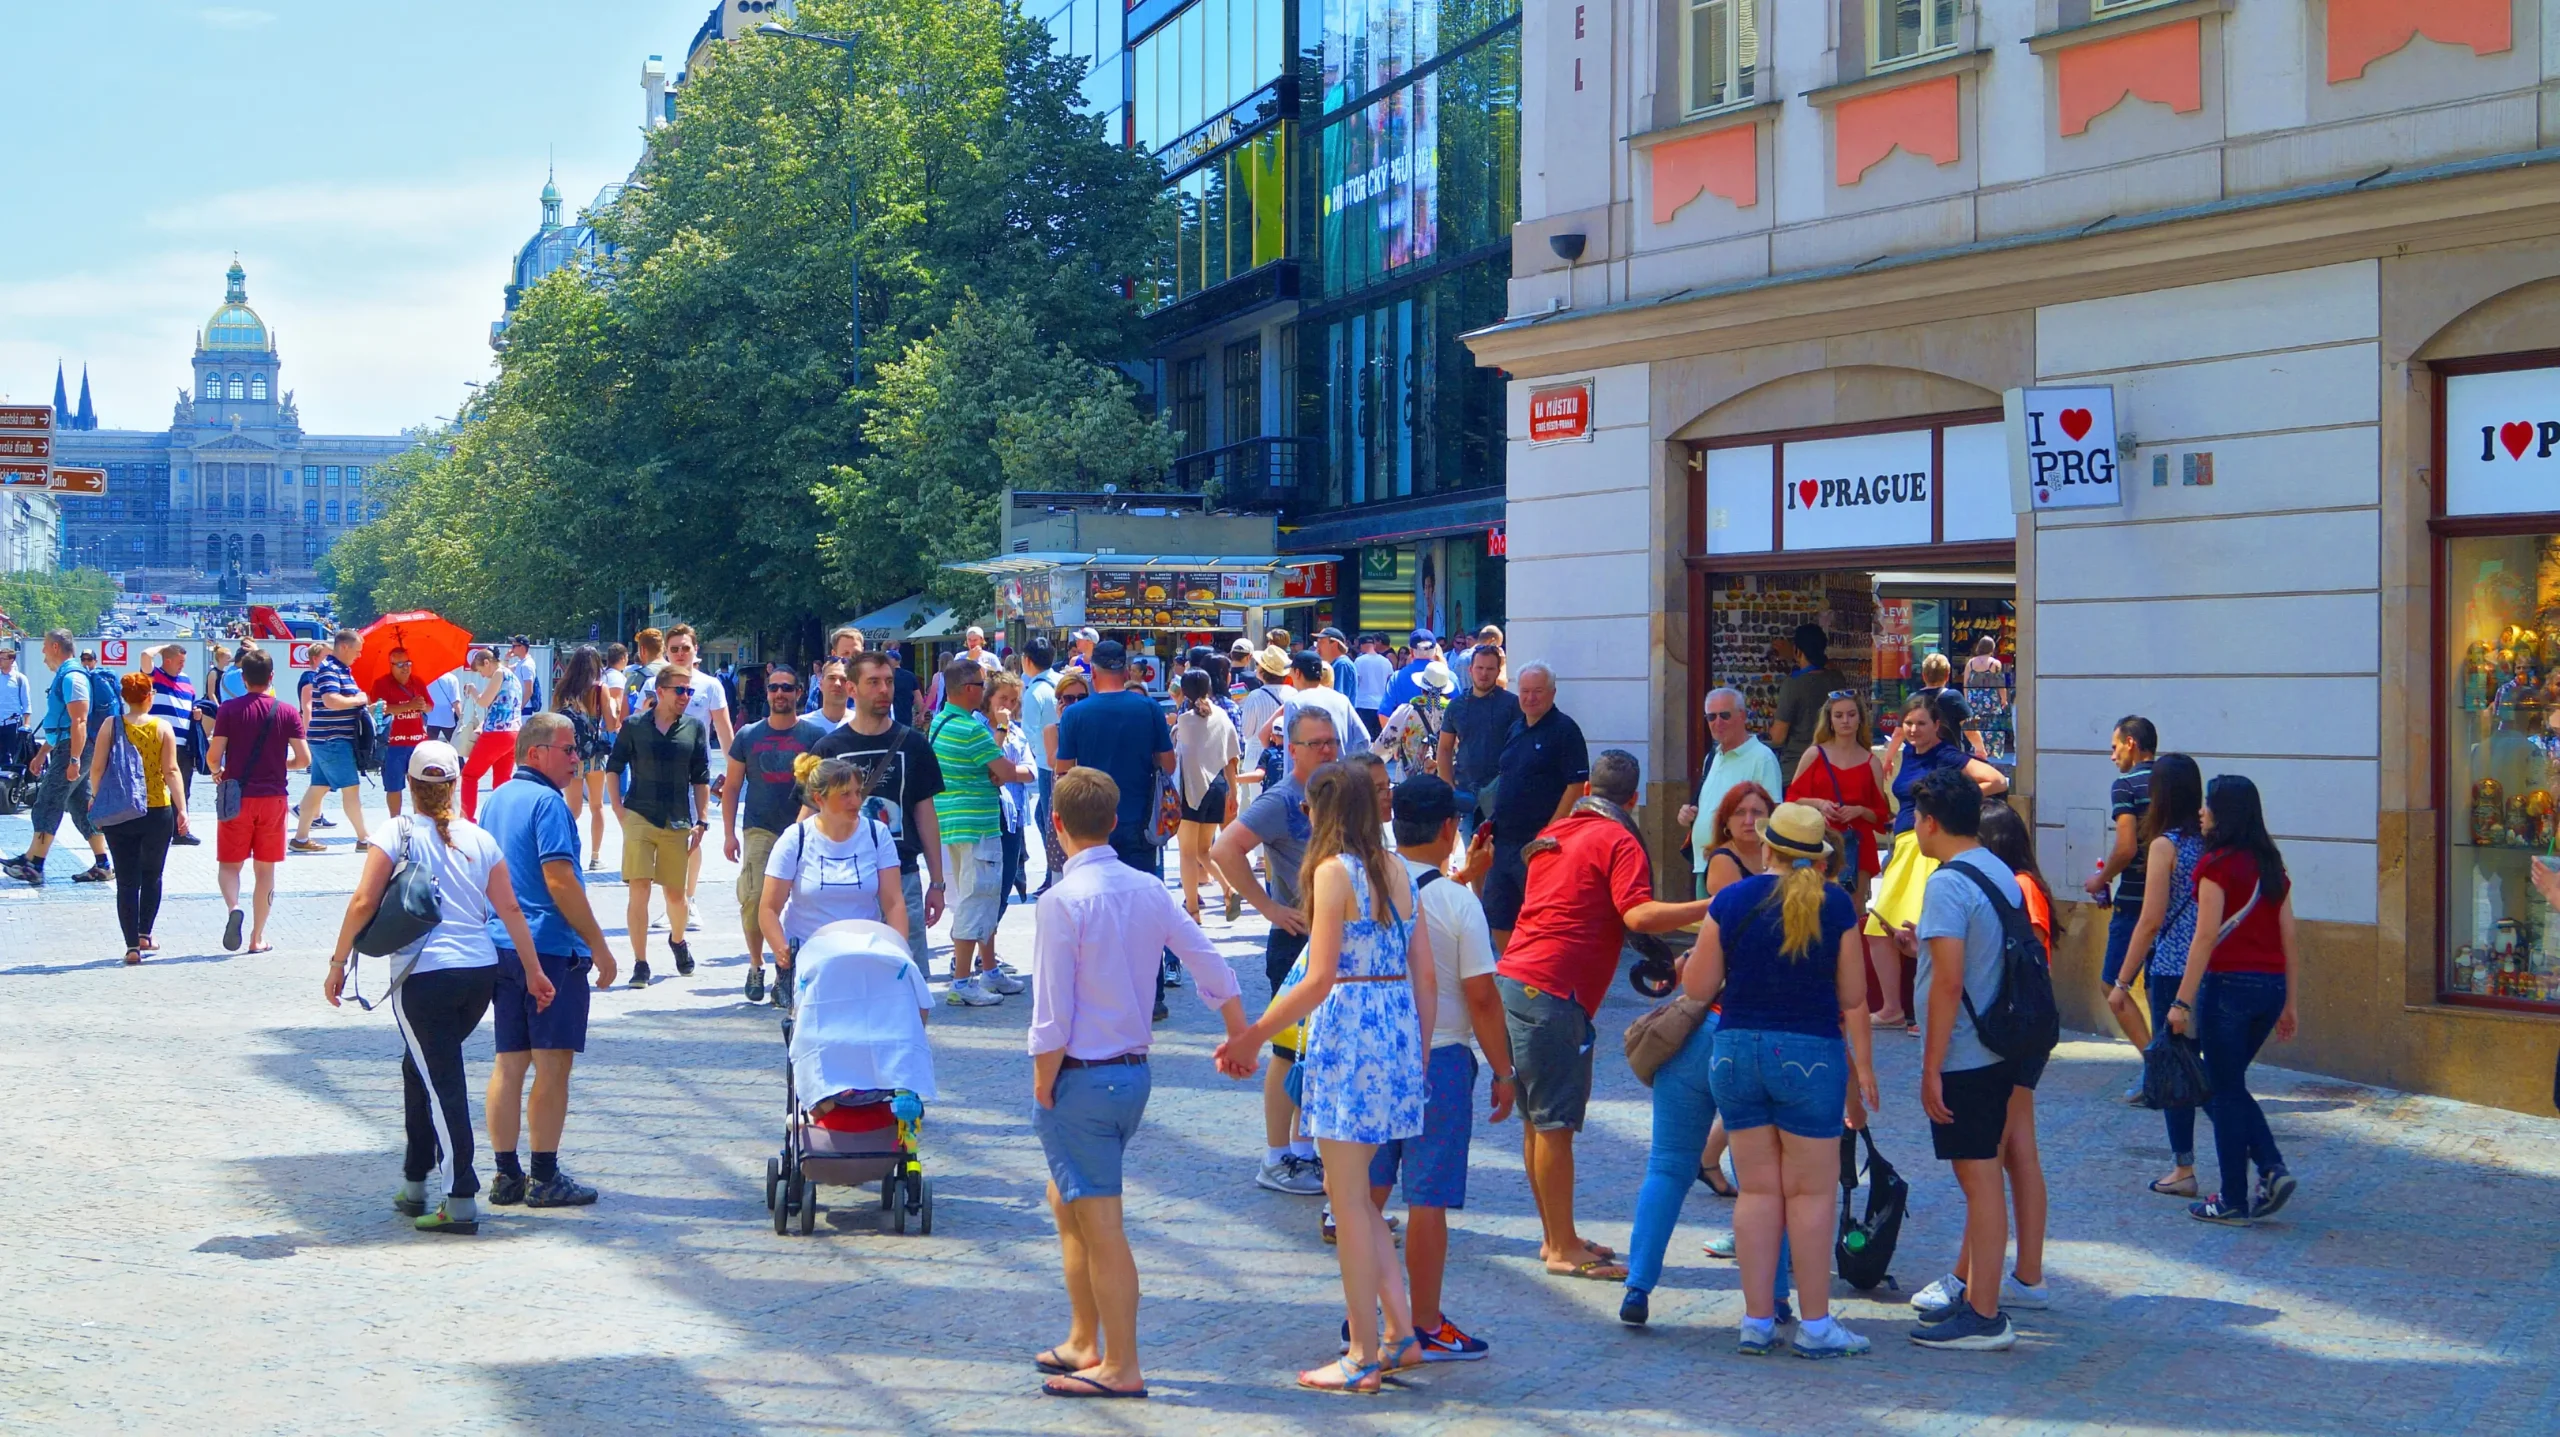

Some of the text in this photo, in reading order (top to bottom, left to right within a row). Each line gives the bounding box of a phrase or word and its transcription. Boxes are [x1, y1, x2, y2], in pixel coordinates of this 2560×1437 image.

[1332, 157, 1389, 213] HITORCKÝ
[1535, 396, 1578, 419] NA MŮSTKU
[15, 440, 34, 453] divadlo
[2029, 412, 2046, 446] I
[2481, 426, 2495, 461] I
[2032, 448, 2115, 487] PRG
[1788, 472, 1926, 510] I PRAGUE
